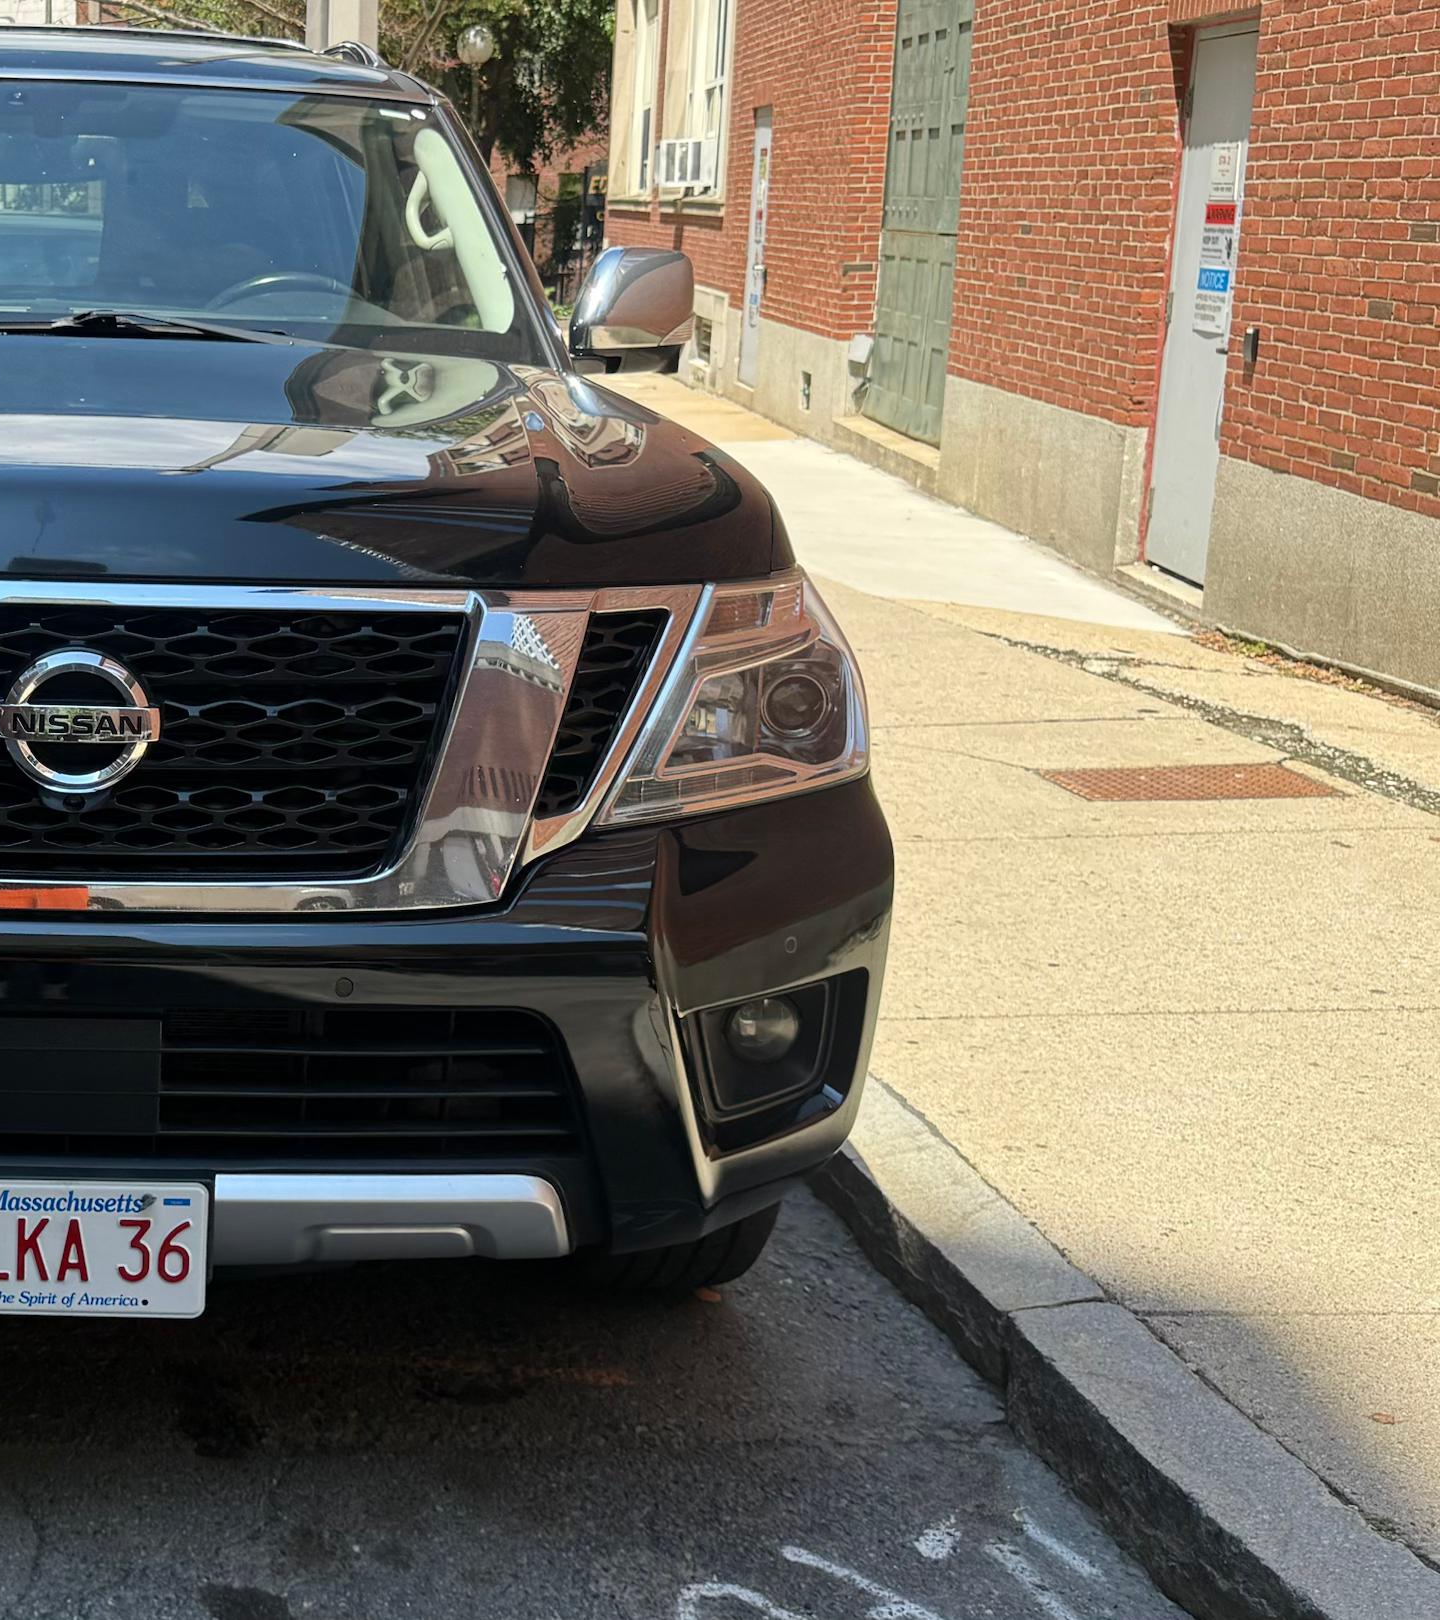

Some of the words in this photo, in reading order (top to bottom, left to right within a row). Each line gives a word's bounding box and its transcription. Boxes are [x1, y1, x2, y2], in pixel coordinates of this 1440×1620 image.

[1199, 271, 1226, 289] NOTICE
[12, 712, 142, 735] NISSAN
[117, 1218, 192, 1284] 36
[18, 1290, 57, 1307] Spirit
[61, 1291, 77, 1308] of
[78, 1292, 139, 1307] America
